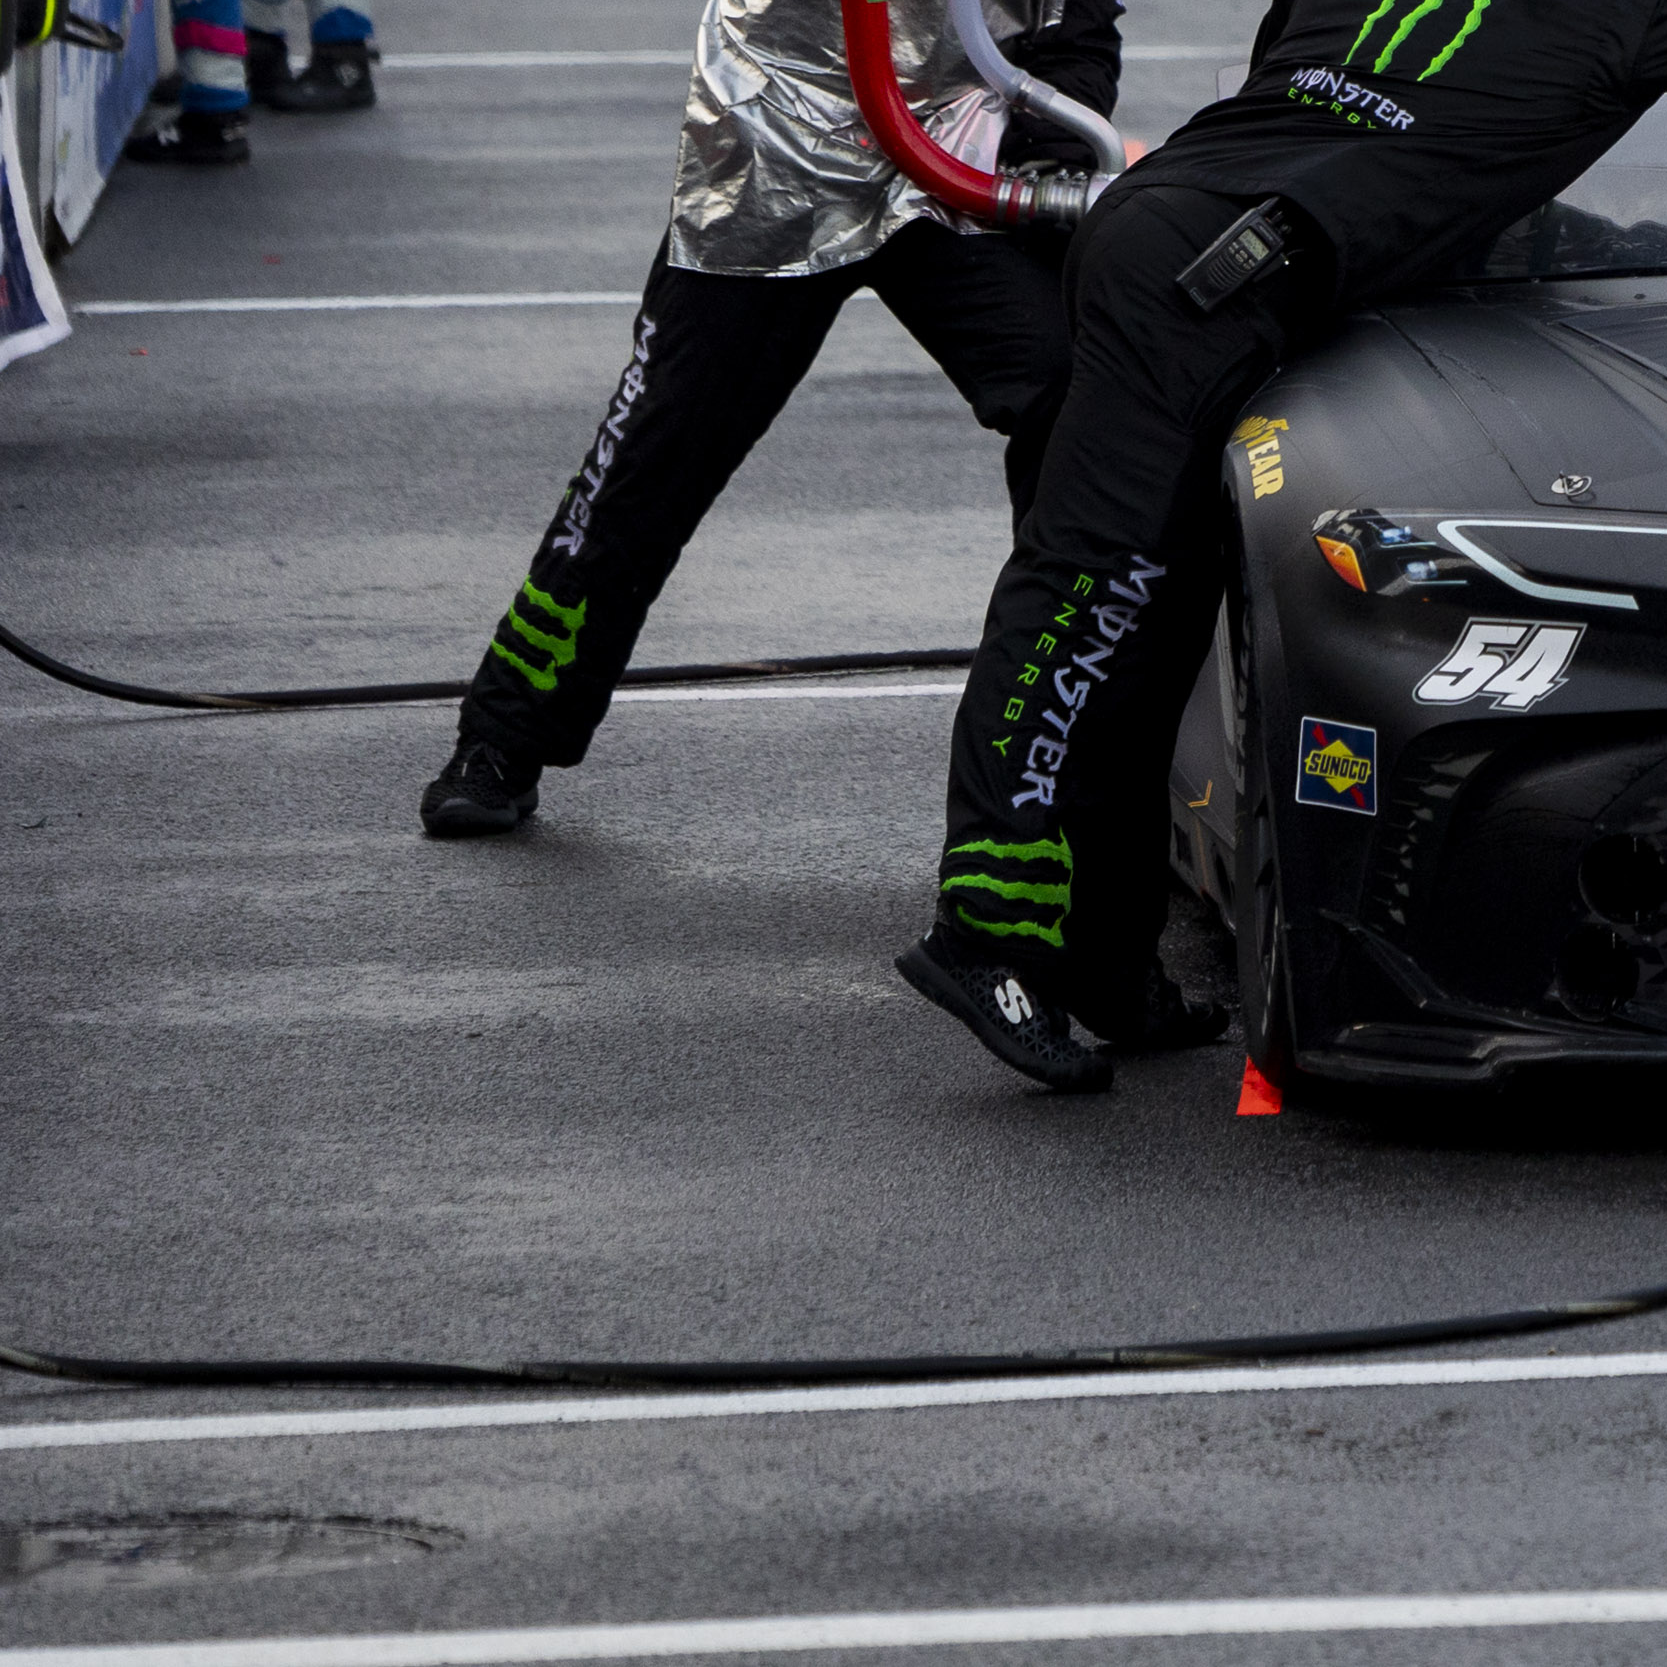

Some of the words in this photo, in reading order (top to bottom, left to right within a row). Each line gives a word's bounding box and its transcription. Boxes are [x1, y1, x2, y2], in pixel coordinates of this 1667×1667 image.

[1289, 66, 1416, 131] MONSTER
[552, 315, 657, 556] MONSTER
[992, 574, 1095, 757] ENERGY
[1011, 555, 1168, 809] MONSTER
[1413, 617, 1588, 712] 54
[1308, 752, 1370, 782] SUNOCO
